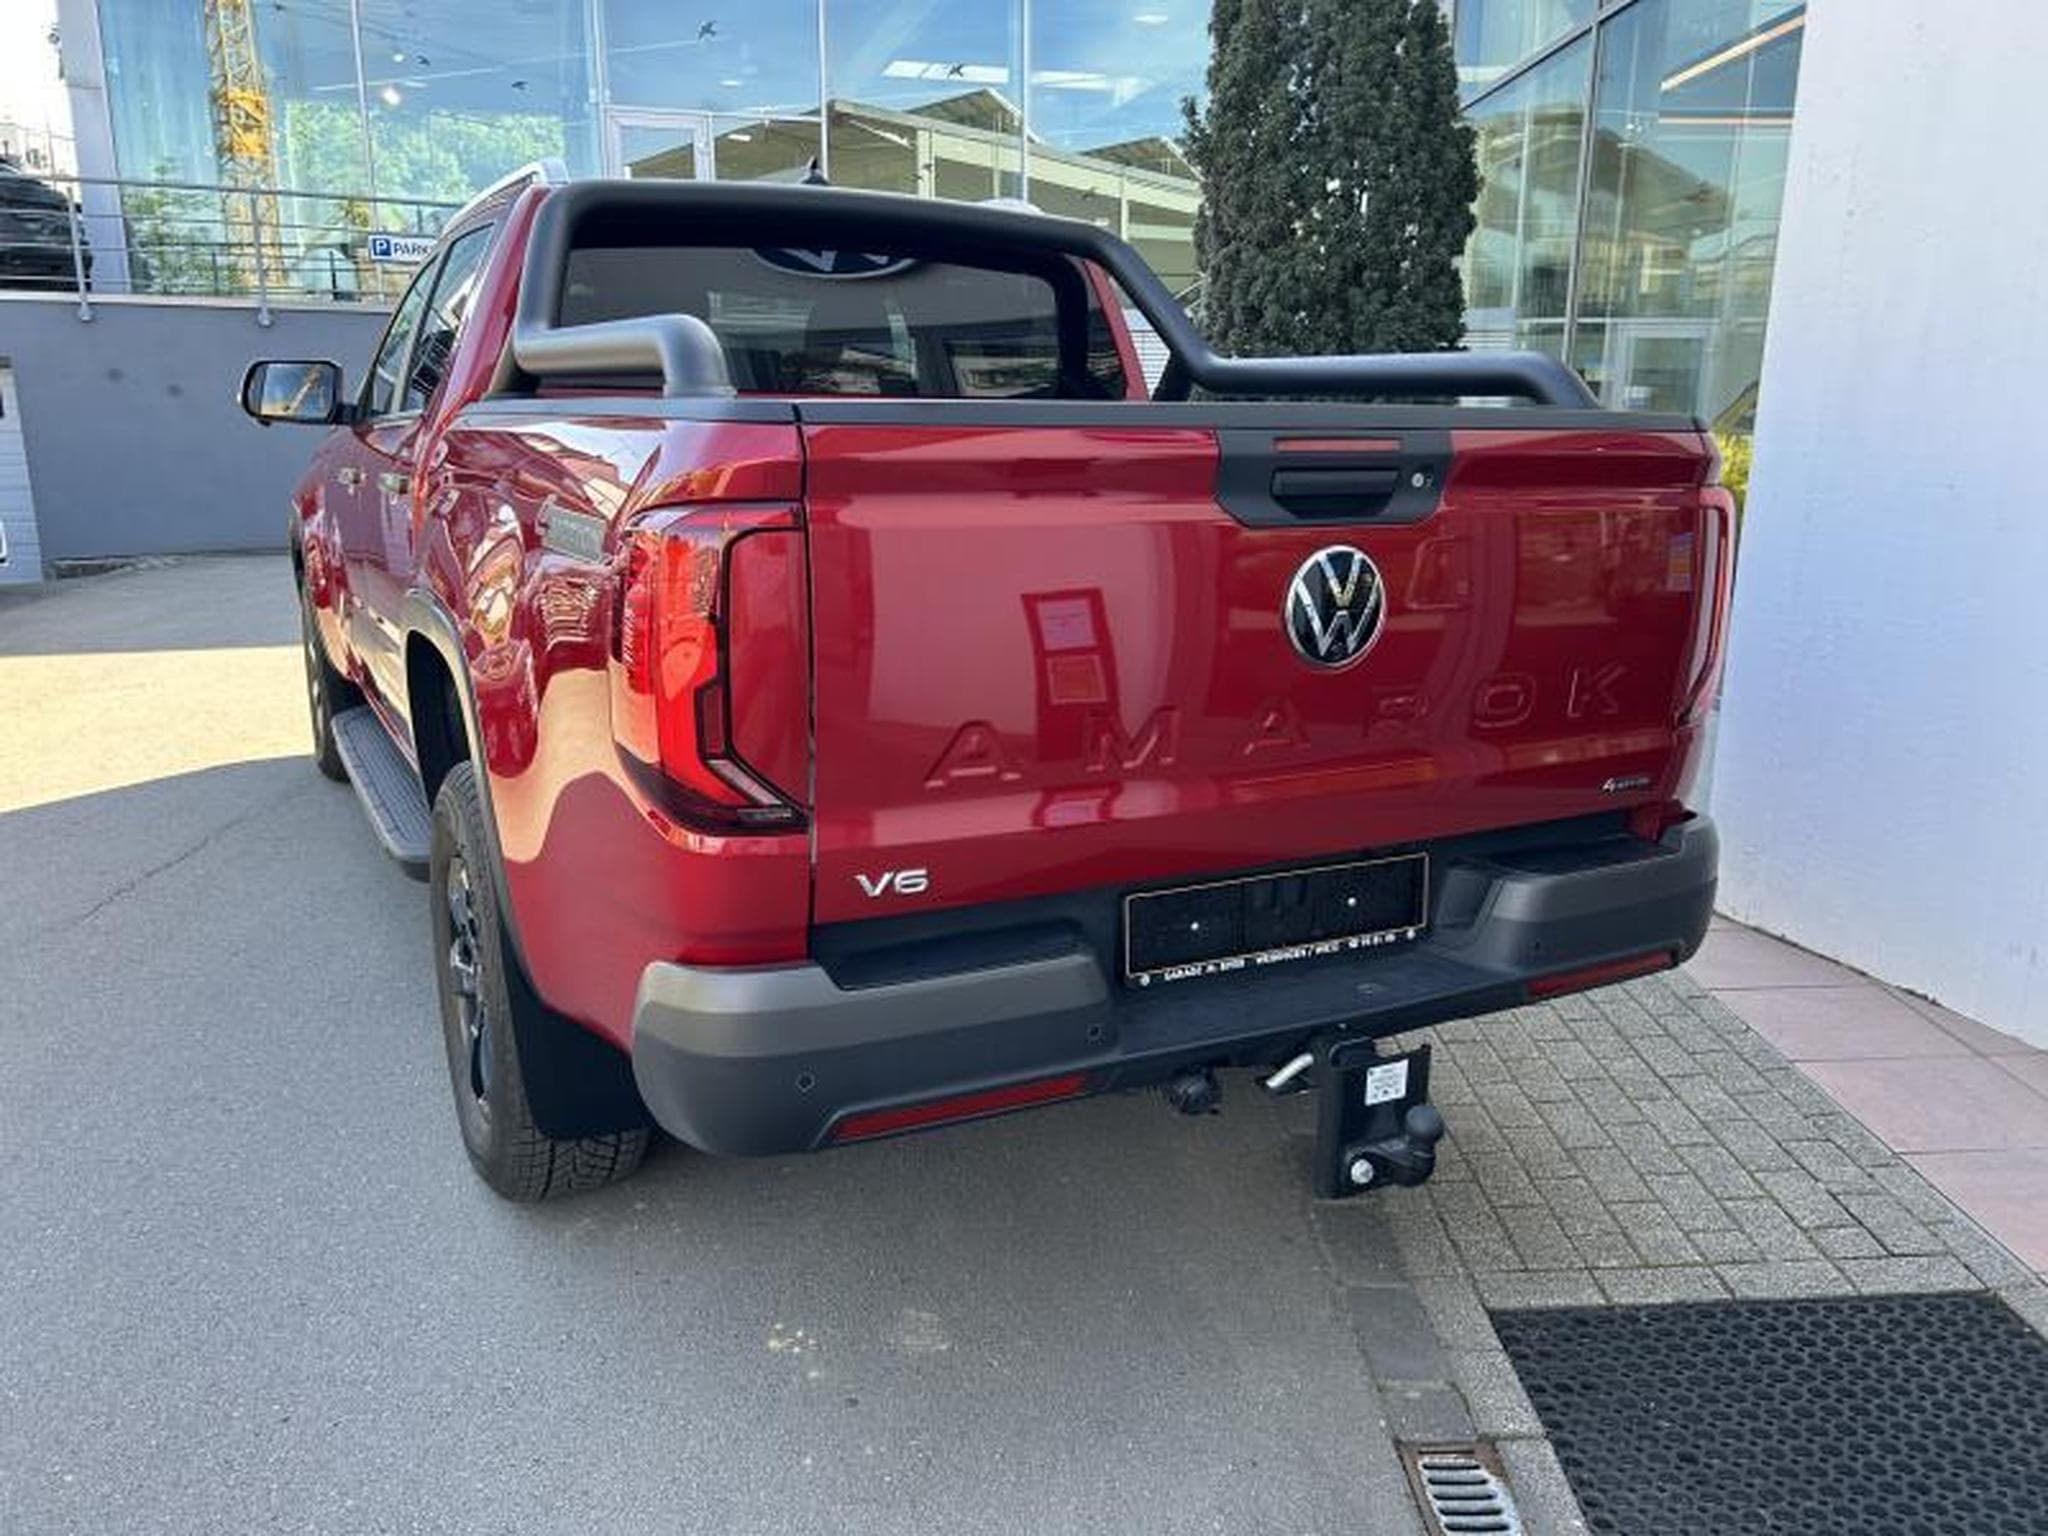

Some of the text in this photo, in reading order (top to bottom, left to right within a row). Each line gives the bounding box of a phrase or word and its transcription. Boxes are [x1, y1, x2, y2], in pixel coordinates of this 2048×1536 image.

[393, 241, 432, 257] PARK
[924, 665, 1628, 790] AMAROK
[853, 868, 929, 897] V6
